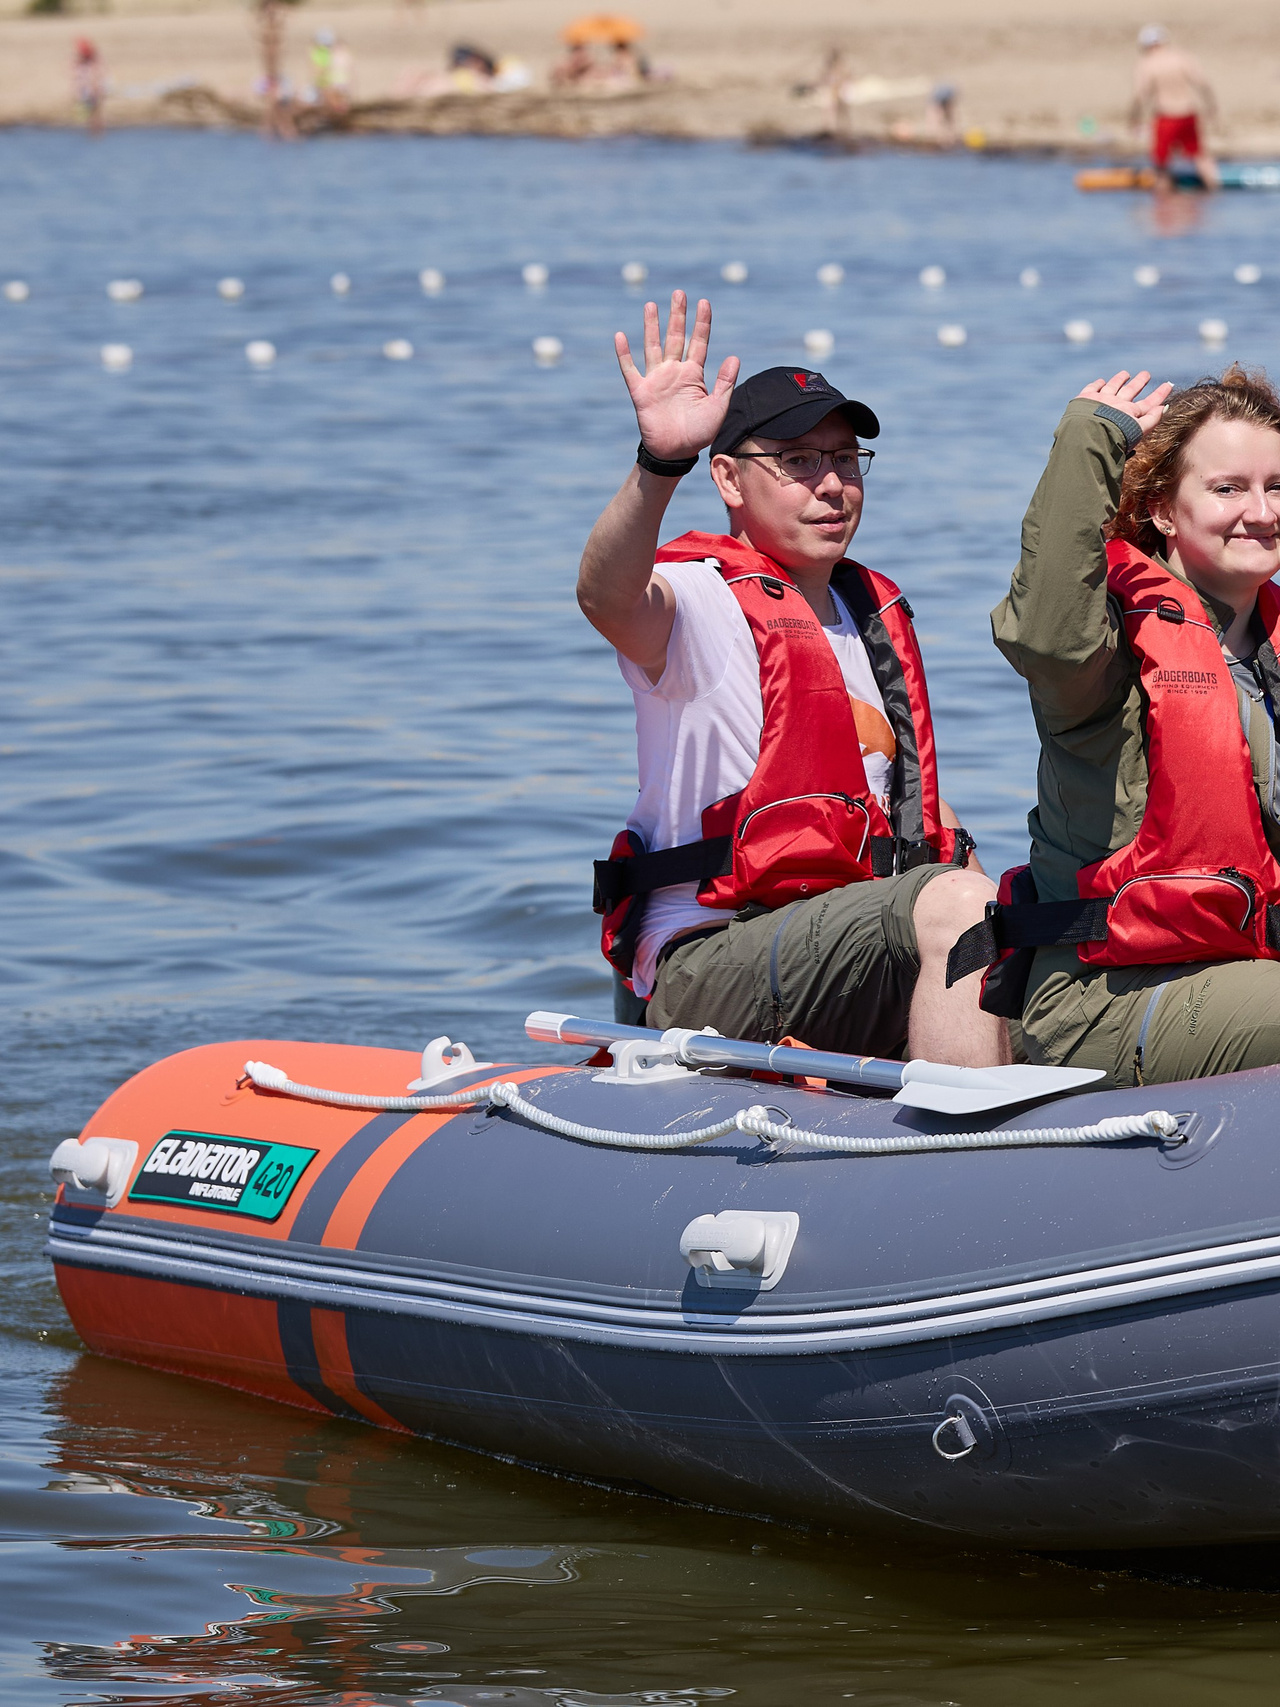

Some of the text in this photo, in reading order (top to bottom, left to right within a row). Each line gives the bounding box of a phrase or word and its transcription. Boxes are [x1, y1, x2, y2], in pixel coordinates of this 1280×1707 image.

[766, 617, 818, 631] BADGERBOATS
[1152, 669, 1218, 685] BADGERBOATS
[252, 1160, 295, 1200] 420
